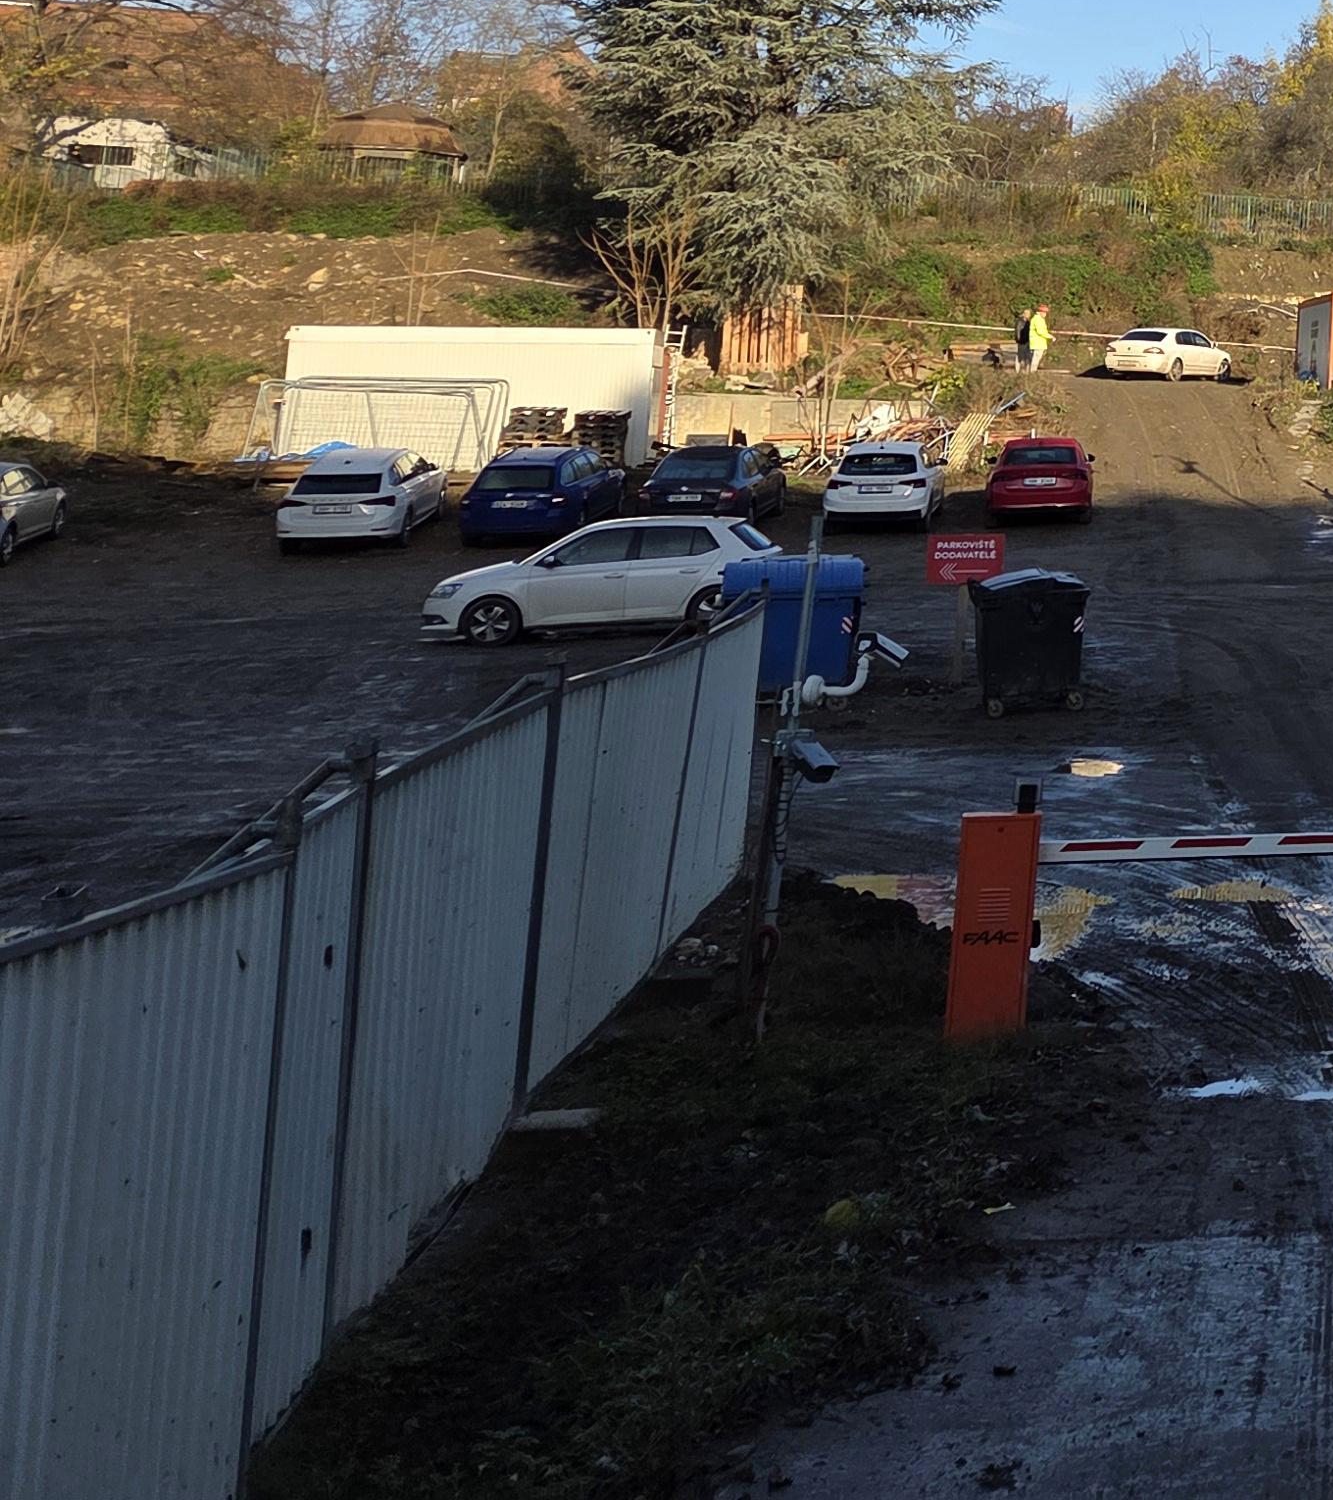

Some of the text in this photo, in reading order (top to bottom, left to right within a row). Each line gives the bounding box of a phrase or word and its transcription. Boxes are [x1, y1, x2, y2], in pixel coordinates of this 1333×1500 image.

[937, 540, 995, 549] PARKOVIŠTĚ
[934, 550, 996, 559] DODAVATELÉ
[962, 930, 1019, 946] FAAC
